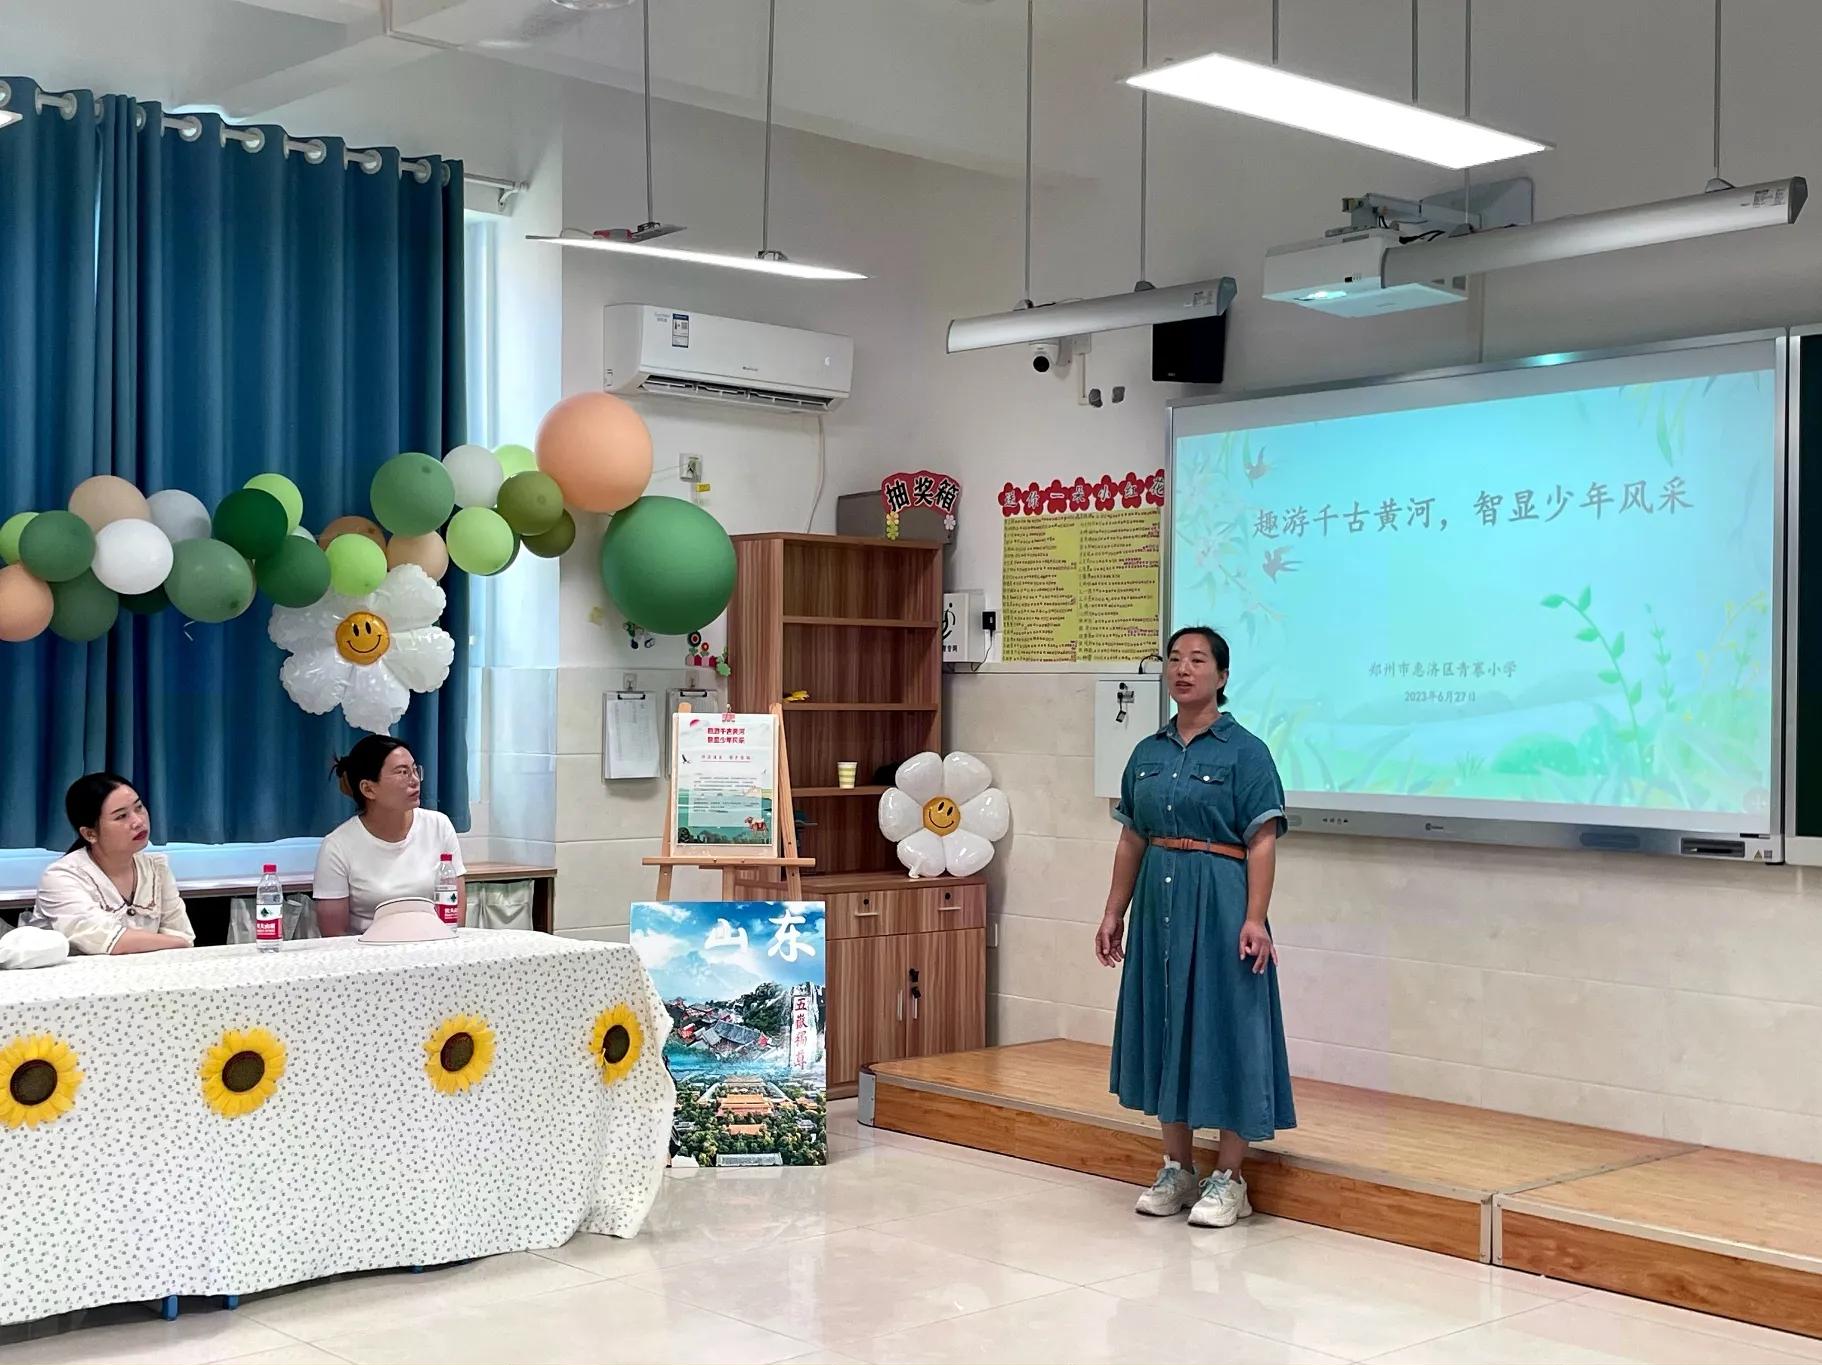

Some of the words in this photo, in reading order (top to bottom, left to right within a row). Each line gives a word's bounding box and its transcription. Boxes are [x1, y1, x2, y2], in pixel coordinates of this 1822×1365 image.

[886, 477, 959, 512] 抽奖箱
[1003, 476, 1165, 508] 送你一朵小红花
[704, 909, 817, 962] 山东
